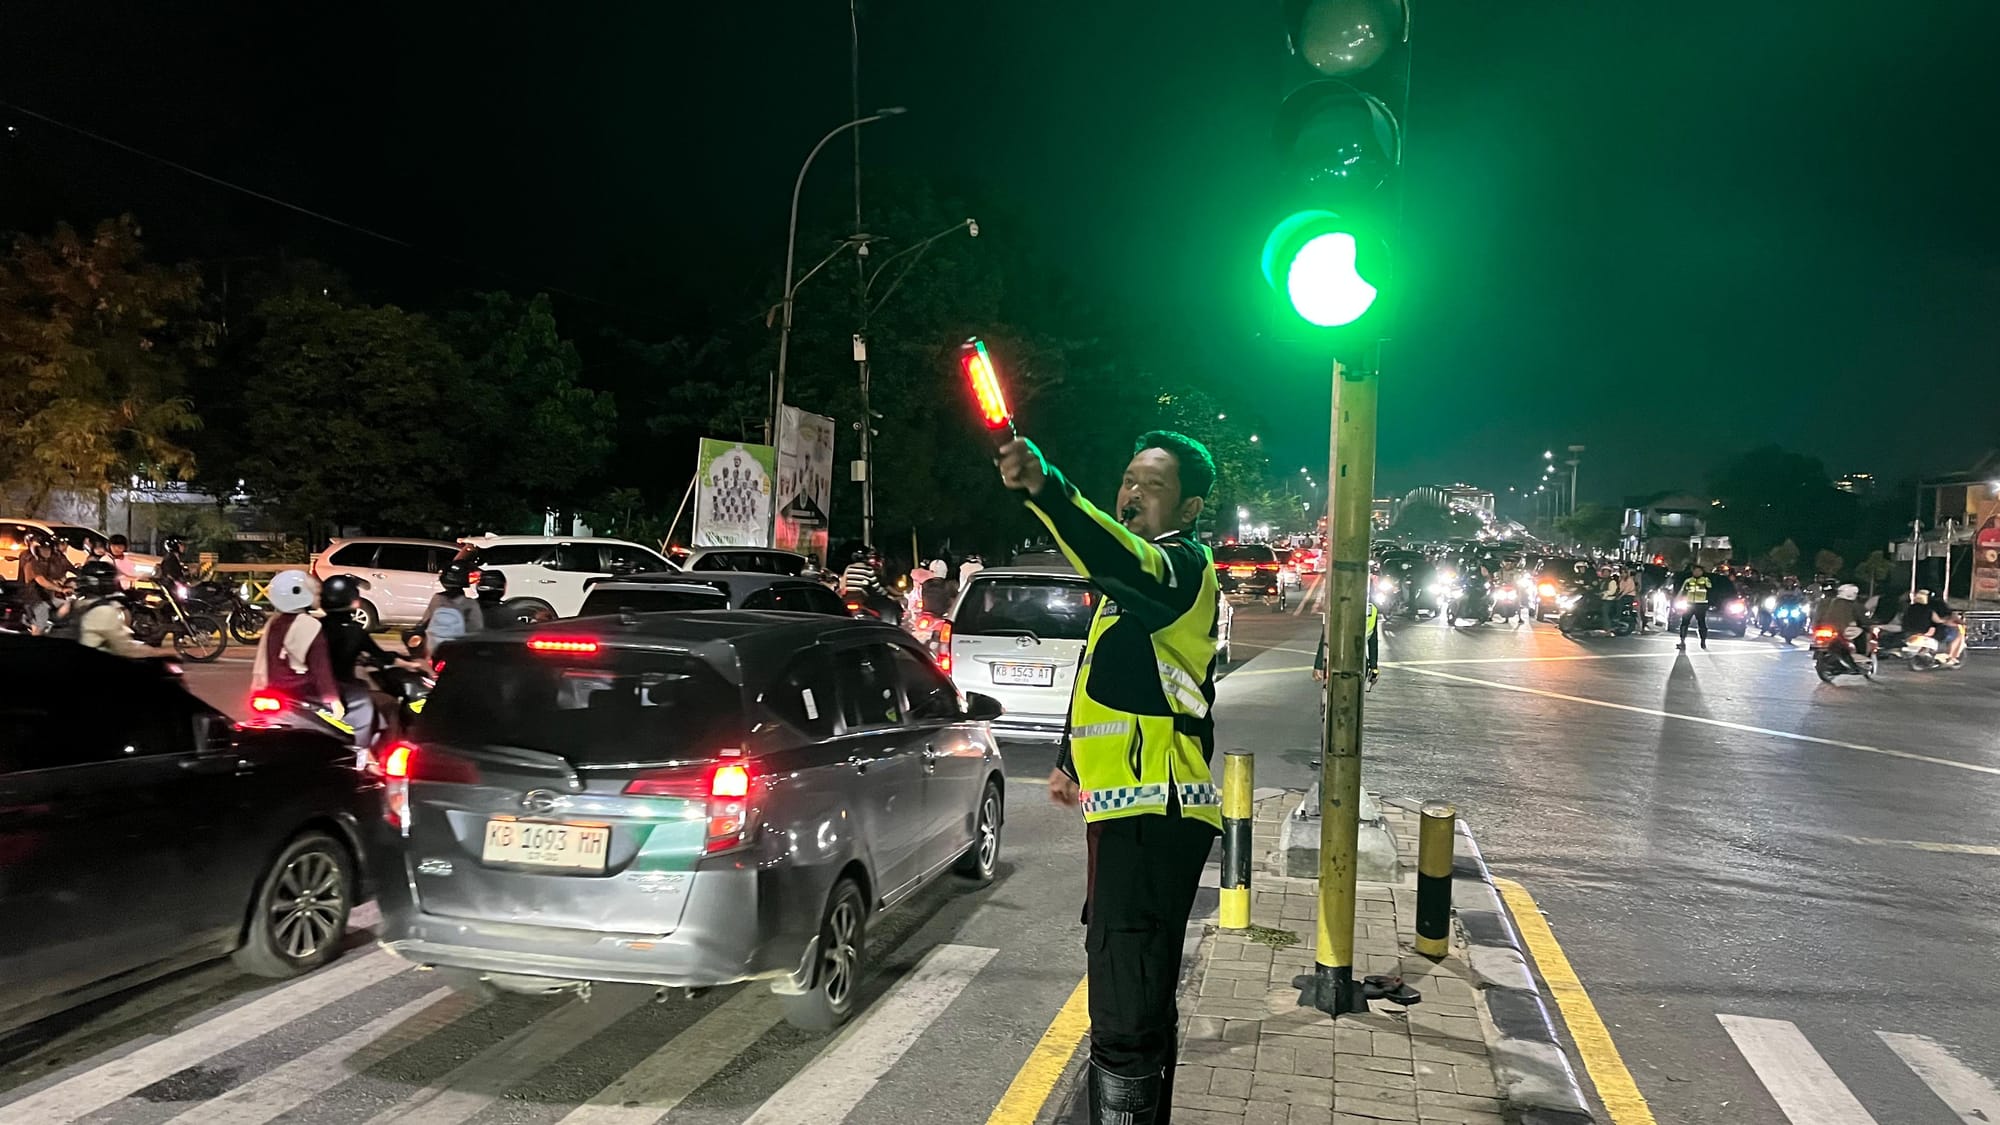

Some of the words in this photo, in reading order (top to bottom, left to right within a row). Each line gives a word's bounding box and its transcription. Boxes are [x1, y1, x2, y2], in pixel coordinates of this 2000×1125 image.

[995, 666, 1007, 677] KB
[1038, 668, 1050, 679] AT
[488, 824, 513, 847] KB
[520, 826, 568, 851] 1693
